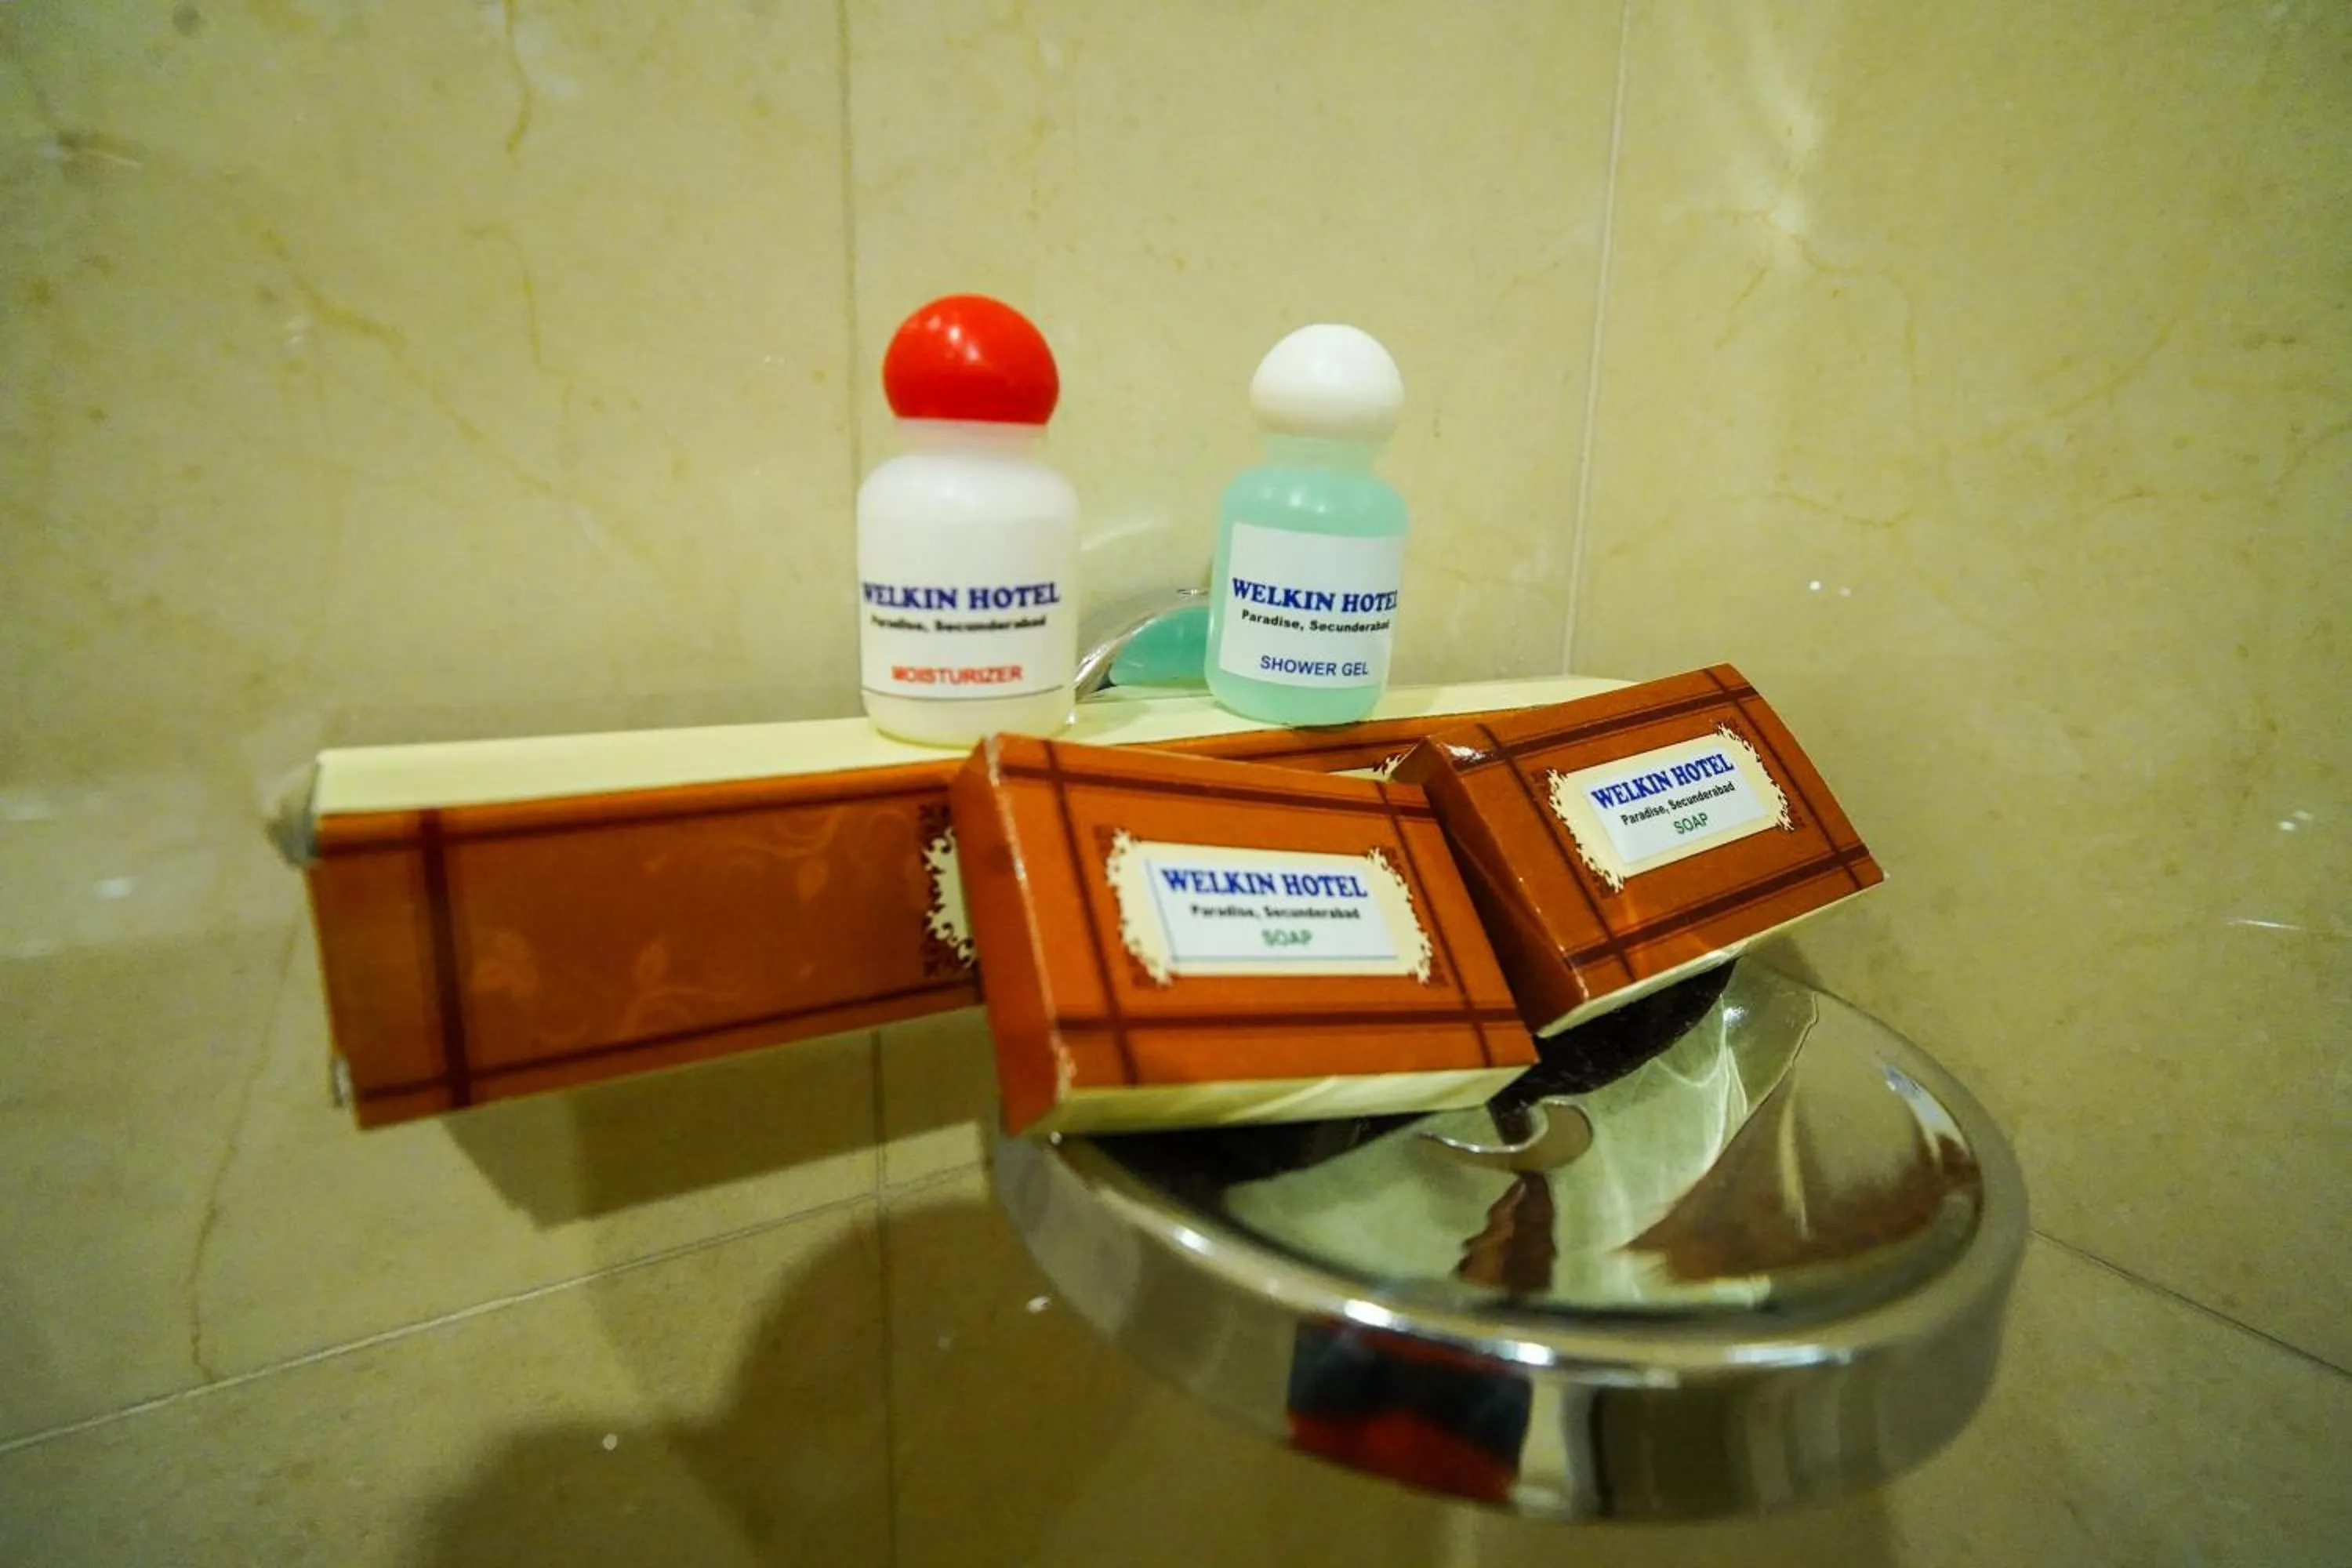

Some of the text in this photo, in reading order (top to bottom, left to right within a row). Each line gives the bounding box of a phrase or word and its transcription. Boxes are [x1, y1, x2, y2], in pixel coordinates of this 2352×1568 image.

[968, 581, 1061, 609] HOTEL
[1232, 577, 1336, 612] WELKIN
[1241, 608, 1304, 631] Paradise,
[891, 665, 1022, 684] MOISTURIZER
[1261, 655, 1369, 677] SHOWER GEL
[1591, 753, 1735, 809] WELKIN HOTEL
[1620, 781, 1736, 826] Paradise, Secunderabad
[1673, 811, 1709, 835] SOAP
[1161, 868, 1369, 898] WELKIN HOTEL
[1190, 904, 1361, 920] Paradise, Secunderabad
[1261, 929, 1312, 946] SOAP
